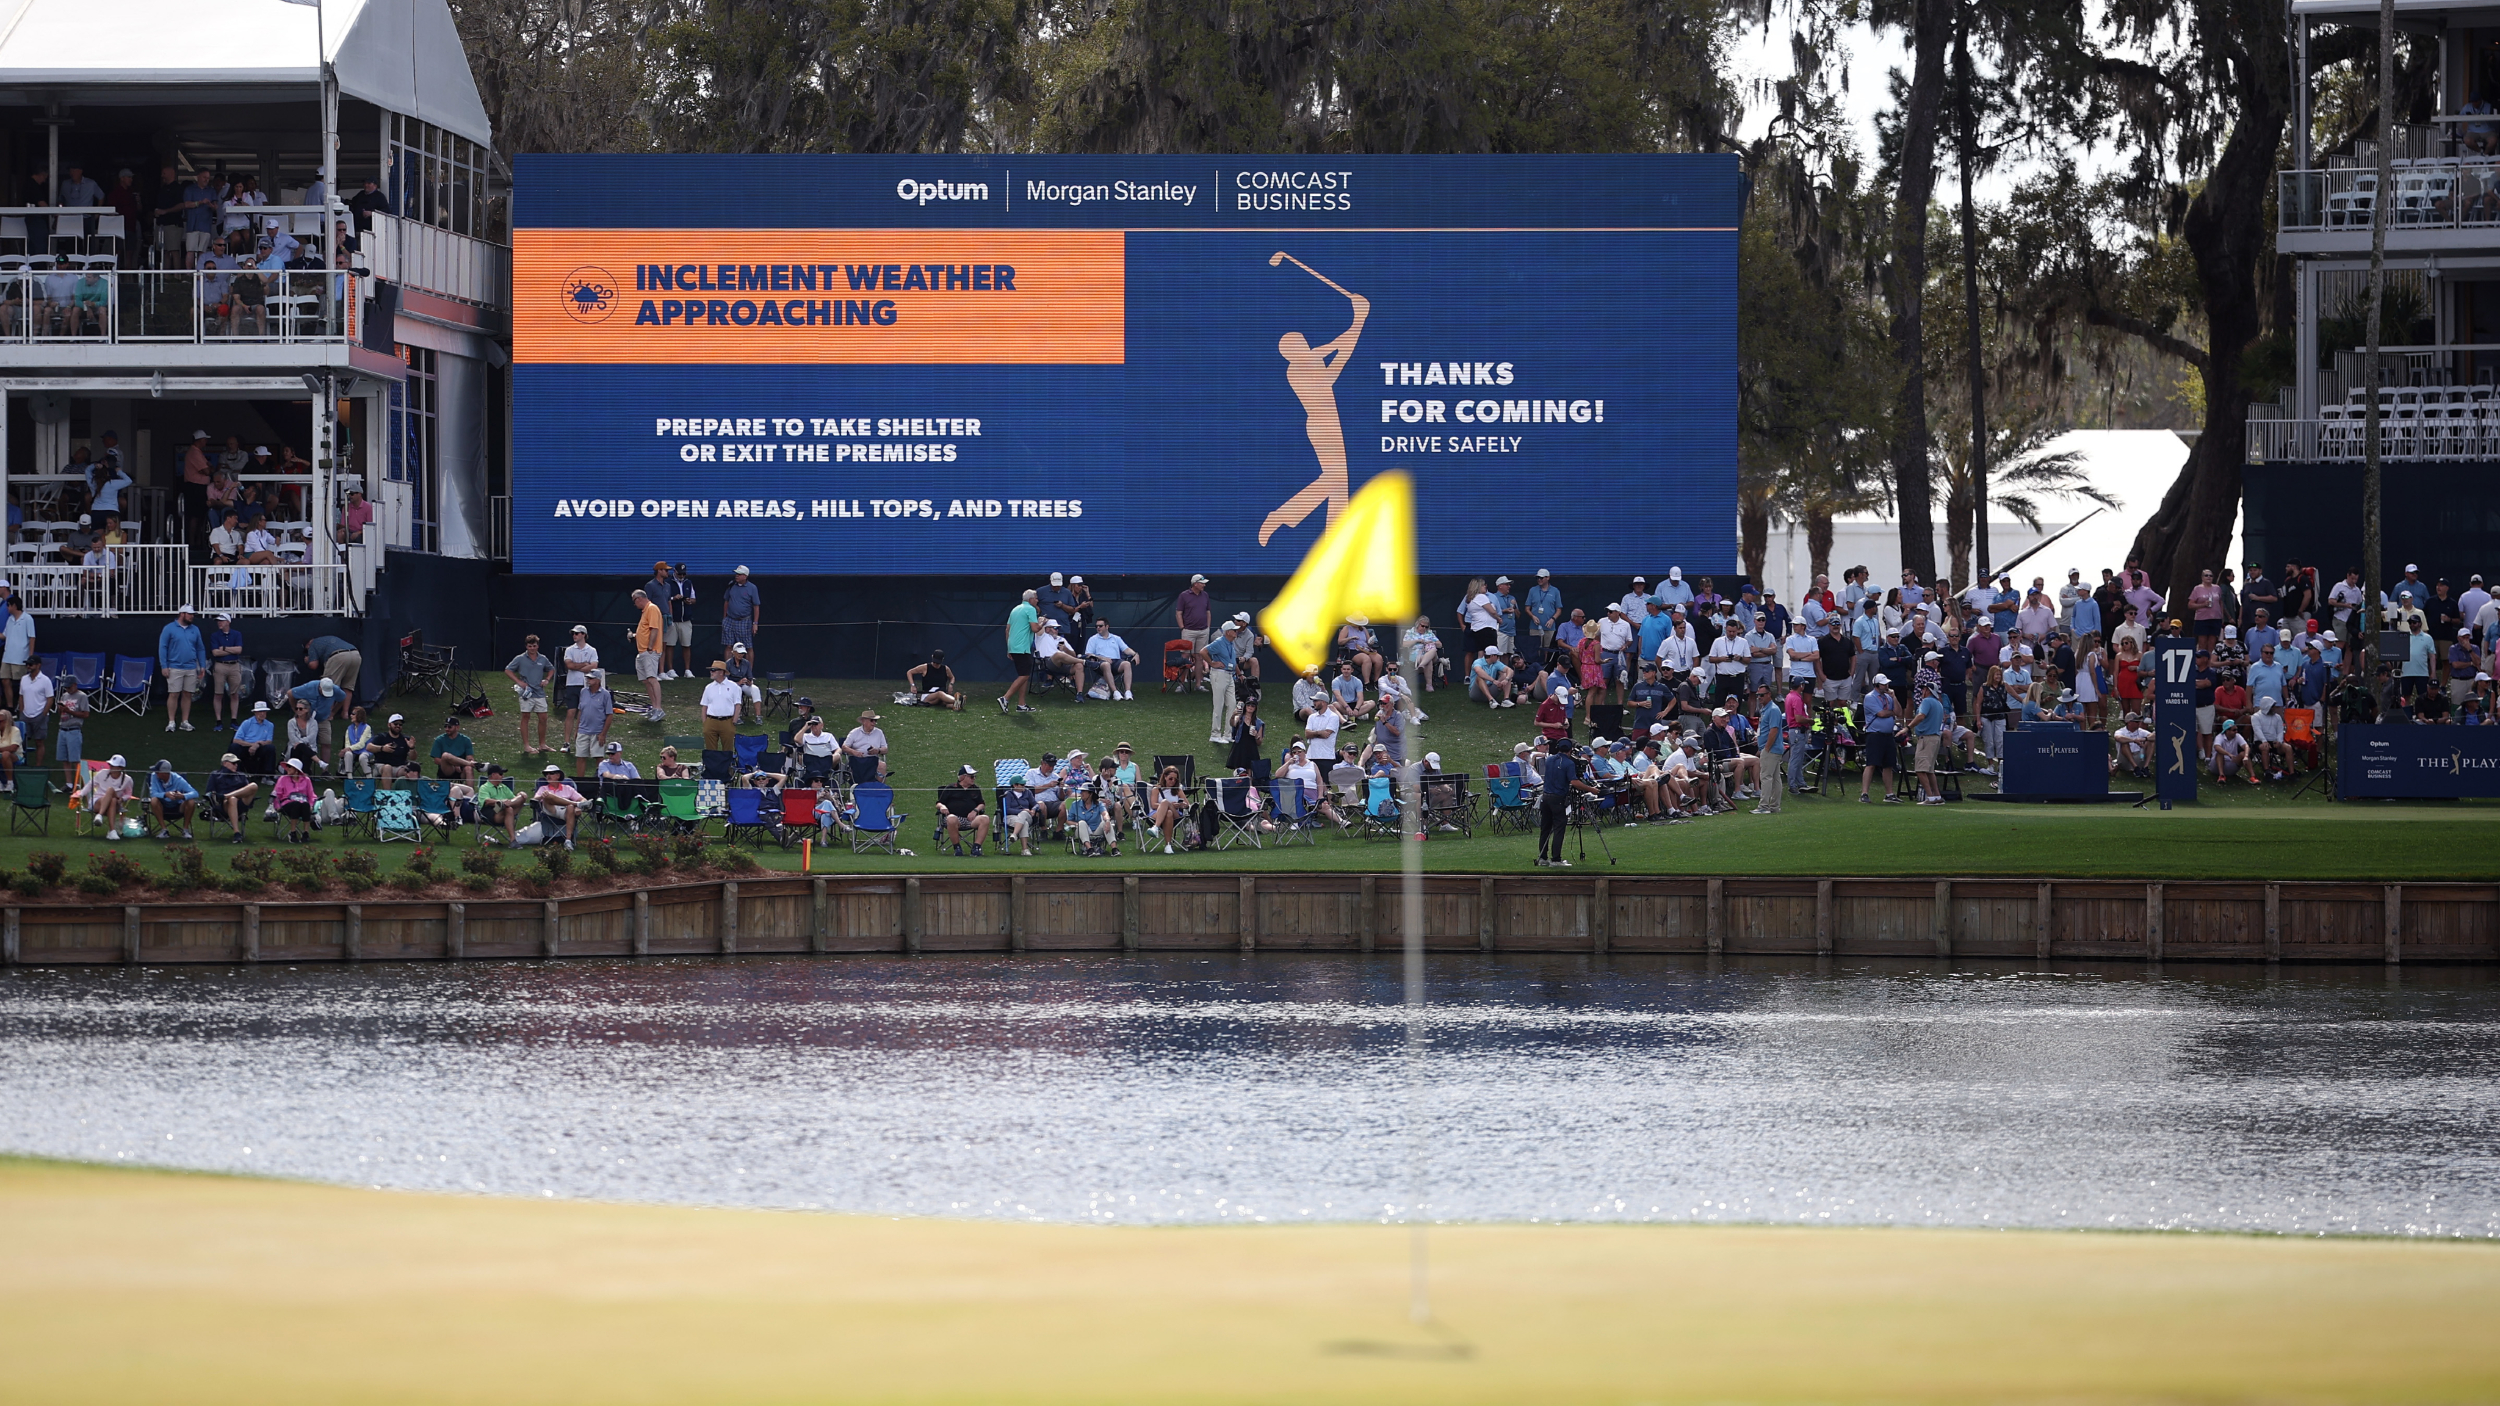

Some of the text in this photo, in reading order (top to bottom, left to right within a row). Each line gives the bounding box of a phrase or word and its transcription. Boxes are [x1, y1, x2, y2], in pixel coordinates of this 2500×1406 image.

[896, 178, 989, 206] Optum
[1236, 171, 1353, 190] COMCAST
[1027, 180, 1197, 207] Morgan Stanley
[1237, 192, 1351, 211] BUSINESS
[636, 264, 1017, 291] INCLEMENT WEATHER
[635, 299, 898, 327] APPROACHING
[1379, 361, 1515, 386] THANKS
[1381, 399, 1604, 424] FOR COMING!
[656, 418, 982, 437] PREPARE TO TAKE SHELTER
[679, 443, 958, 463] OR EXIT THE PREMISES
[1381, 436, 1523, 453] DRIVE SAFELY
[553, 498, 1083, 521] AVOID OPEN AREAS, HILL TOPS, AND TREES
[2162, 649, 2193, 683] 17
[2417, 758, 2500, 768] THE PLAY
